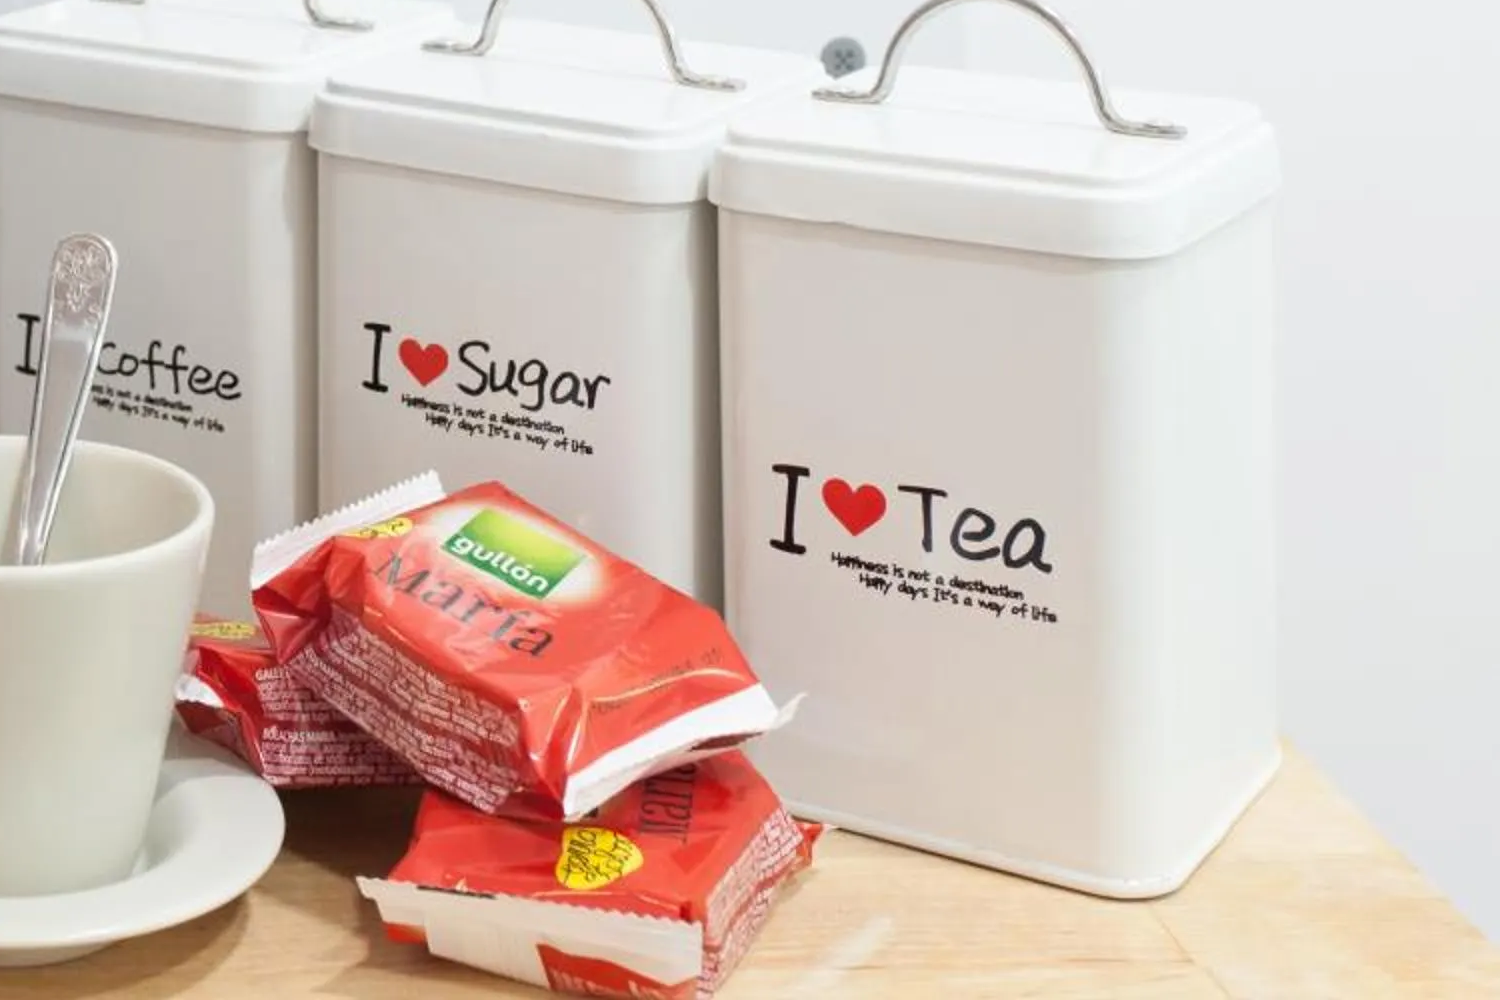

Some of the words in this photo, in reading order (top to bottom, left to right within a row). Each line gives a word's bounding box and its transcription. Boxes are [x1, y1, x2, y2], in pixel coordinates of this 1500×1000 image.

[16, 313, 41, 376] I
[97, 340, 242, 400] Coffee
[362, 322, 391, 393] I
[457, 340, 611, 412] Sugar
[466, 408, 486, 420] not
[501, 412, 565, 435] destination
[513, 431, 521, 440] a
[525, 433, 550, 450] way
[553, 437, 568, 450] of
[770, 464, 810, 555] I
[897, 484, 1053, 574] Tea
[450, 534, 551, 594] gullón
[893, 564, 905, 579] is
[908, 569, 930, 583] not
[935, 575, 945, 586] a
[950, 575, 1024, 600] destination
[859, 573, 893, 596] Happy
[897, 582, 929, 600] days
[963, 595, 973, 607] a
[978, 597, 1006, 617] way
[1011, 603, 1028, 619] of
[1031, 606, 1058, 624] life
